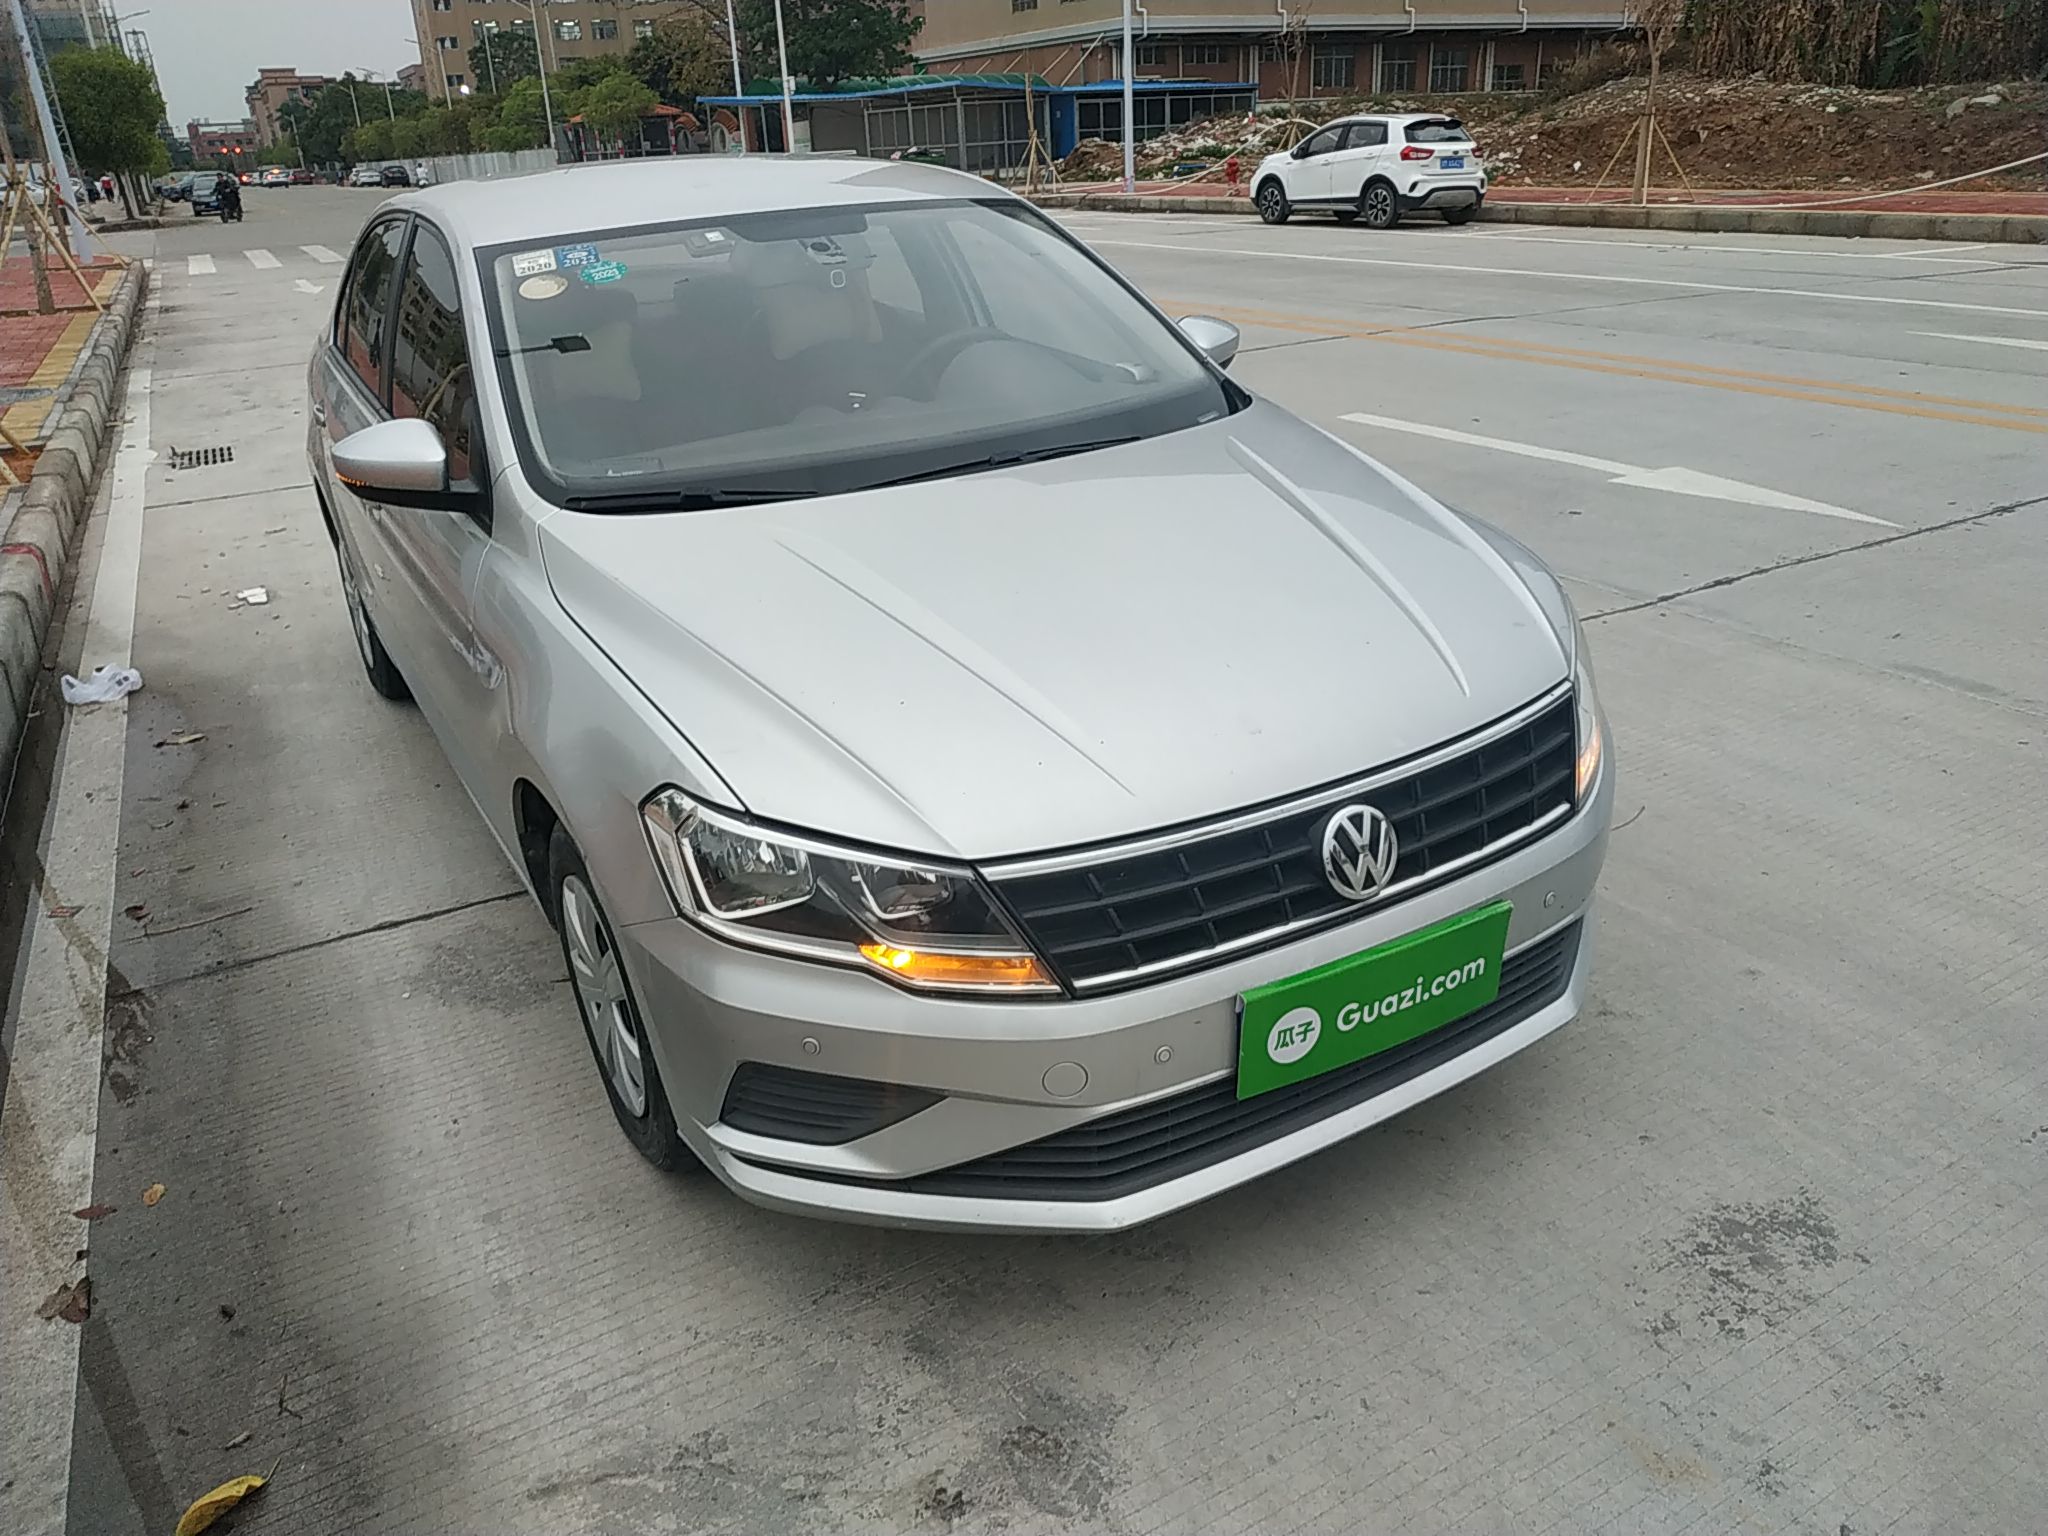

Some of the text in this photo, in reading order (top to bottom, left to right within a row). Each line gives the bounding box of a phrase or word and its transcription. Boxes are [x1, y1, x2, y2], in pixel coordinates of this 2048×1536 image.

[520, 262, 552, 275] 2020
[562, 255, 597, 267] 2022
[1336, 957, 1486, 1032] Guazi.com
[1274, 1022, 1315, 1052] 瓜子
